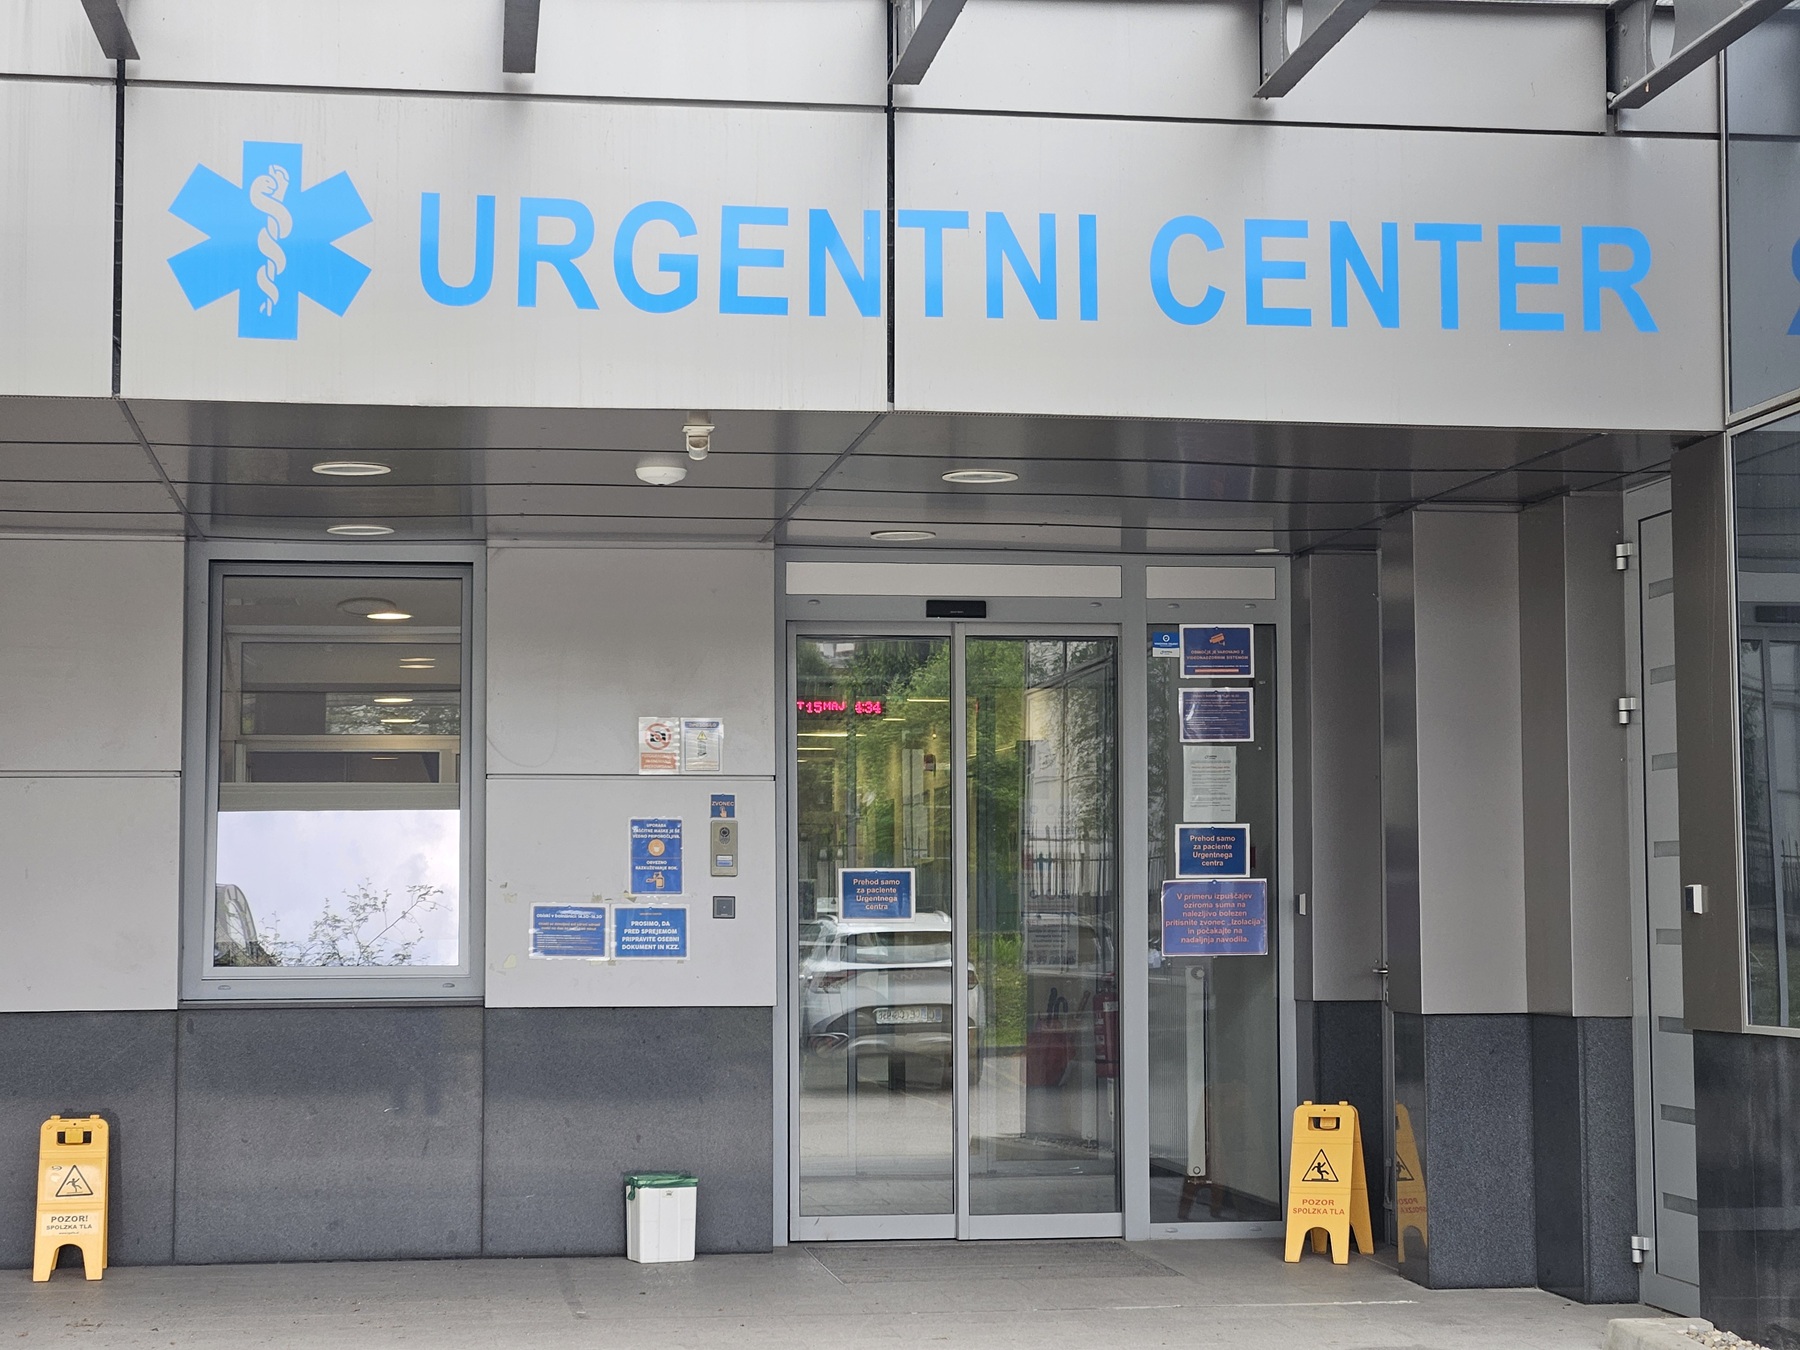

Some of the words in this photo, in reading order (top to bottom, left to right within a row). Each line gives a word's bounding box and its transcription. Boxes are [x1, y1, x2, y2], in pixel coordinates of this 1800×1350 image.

[419, 191, 1099, 322] URGENTNI
[1149, 215, 1660, 334] CENTER
[1192, 851, 1233, 860] Urgentnega
[856, 895, 898, 903] Urgentnega
[1183, 893, 1212, 901] primeru
[1214, 892, 1253, 901] izpuščajev
[1182, 910, 1217, 918] nalezljivo
[1165, 919, 1198, 927] pritisnite
[1196, 927, 1232, 935] počakajte
[1180, 936, 1215, 944] nadaljnja
[1292, 1207, 1328, 1215] SPOLZKA
[51, 1215, 89, 1223] POZOR!
